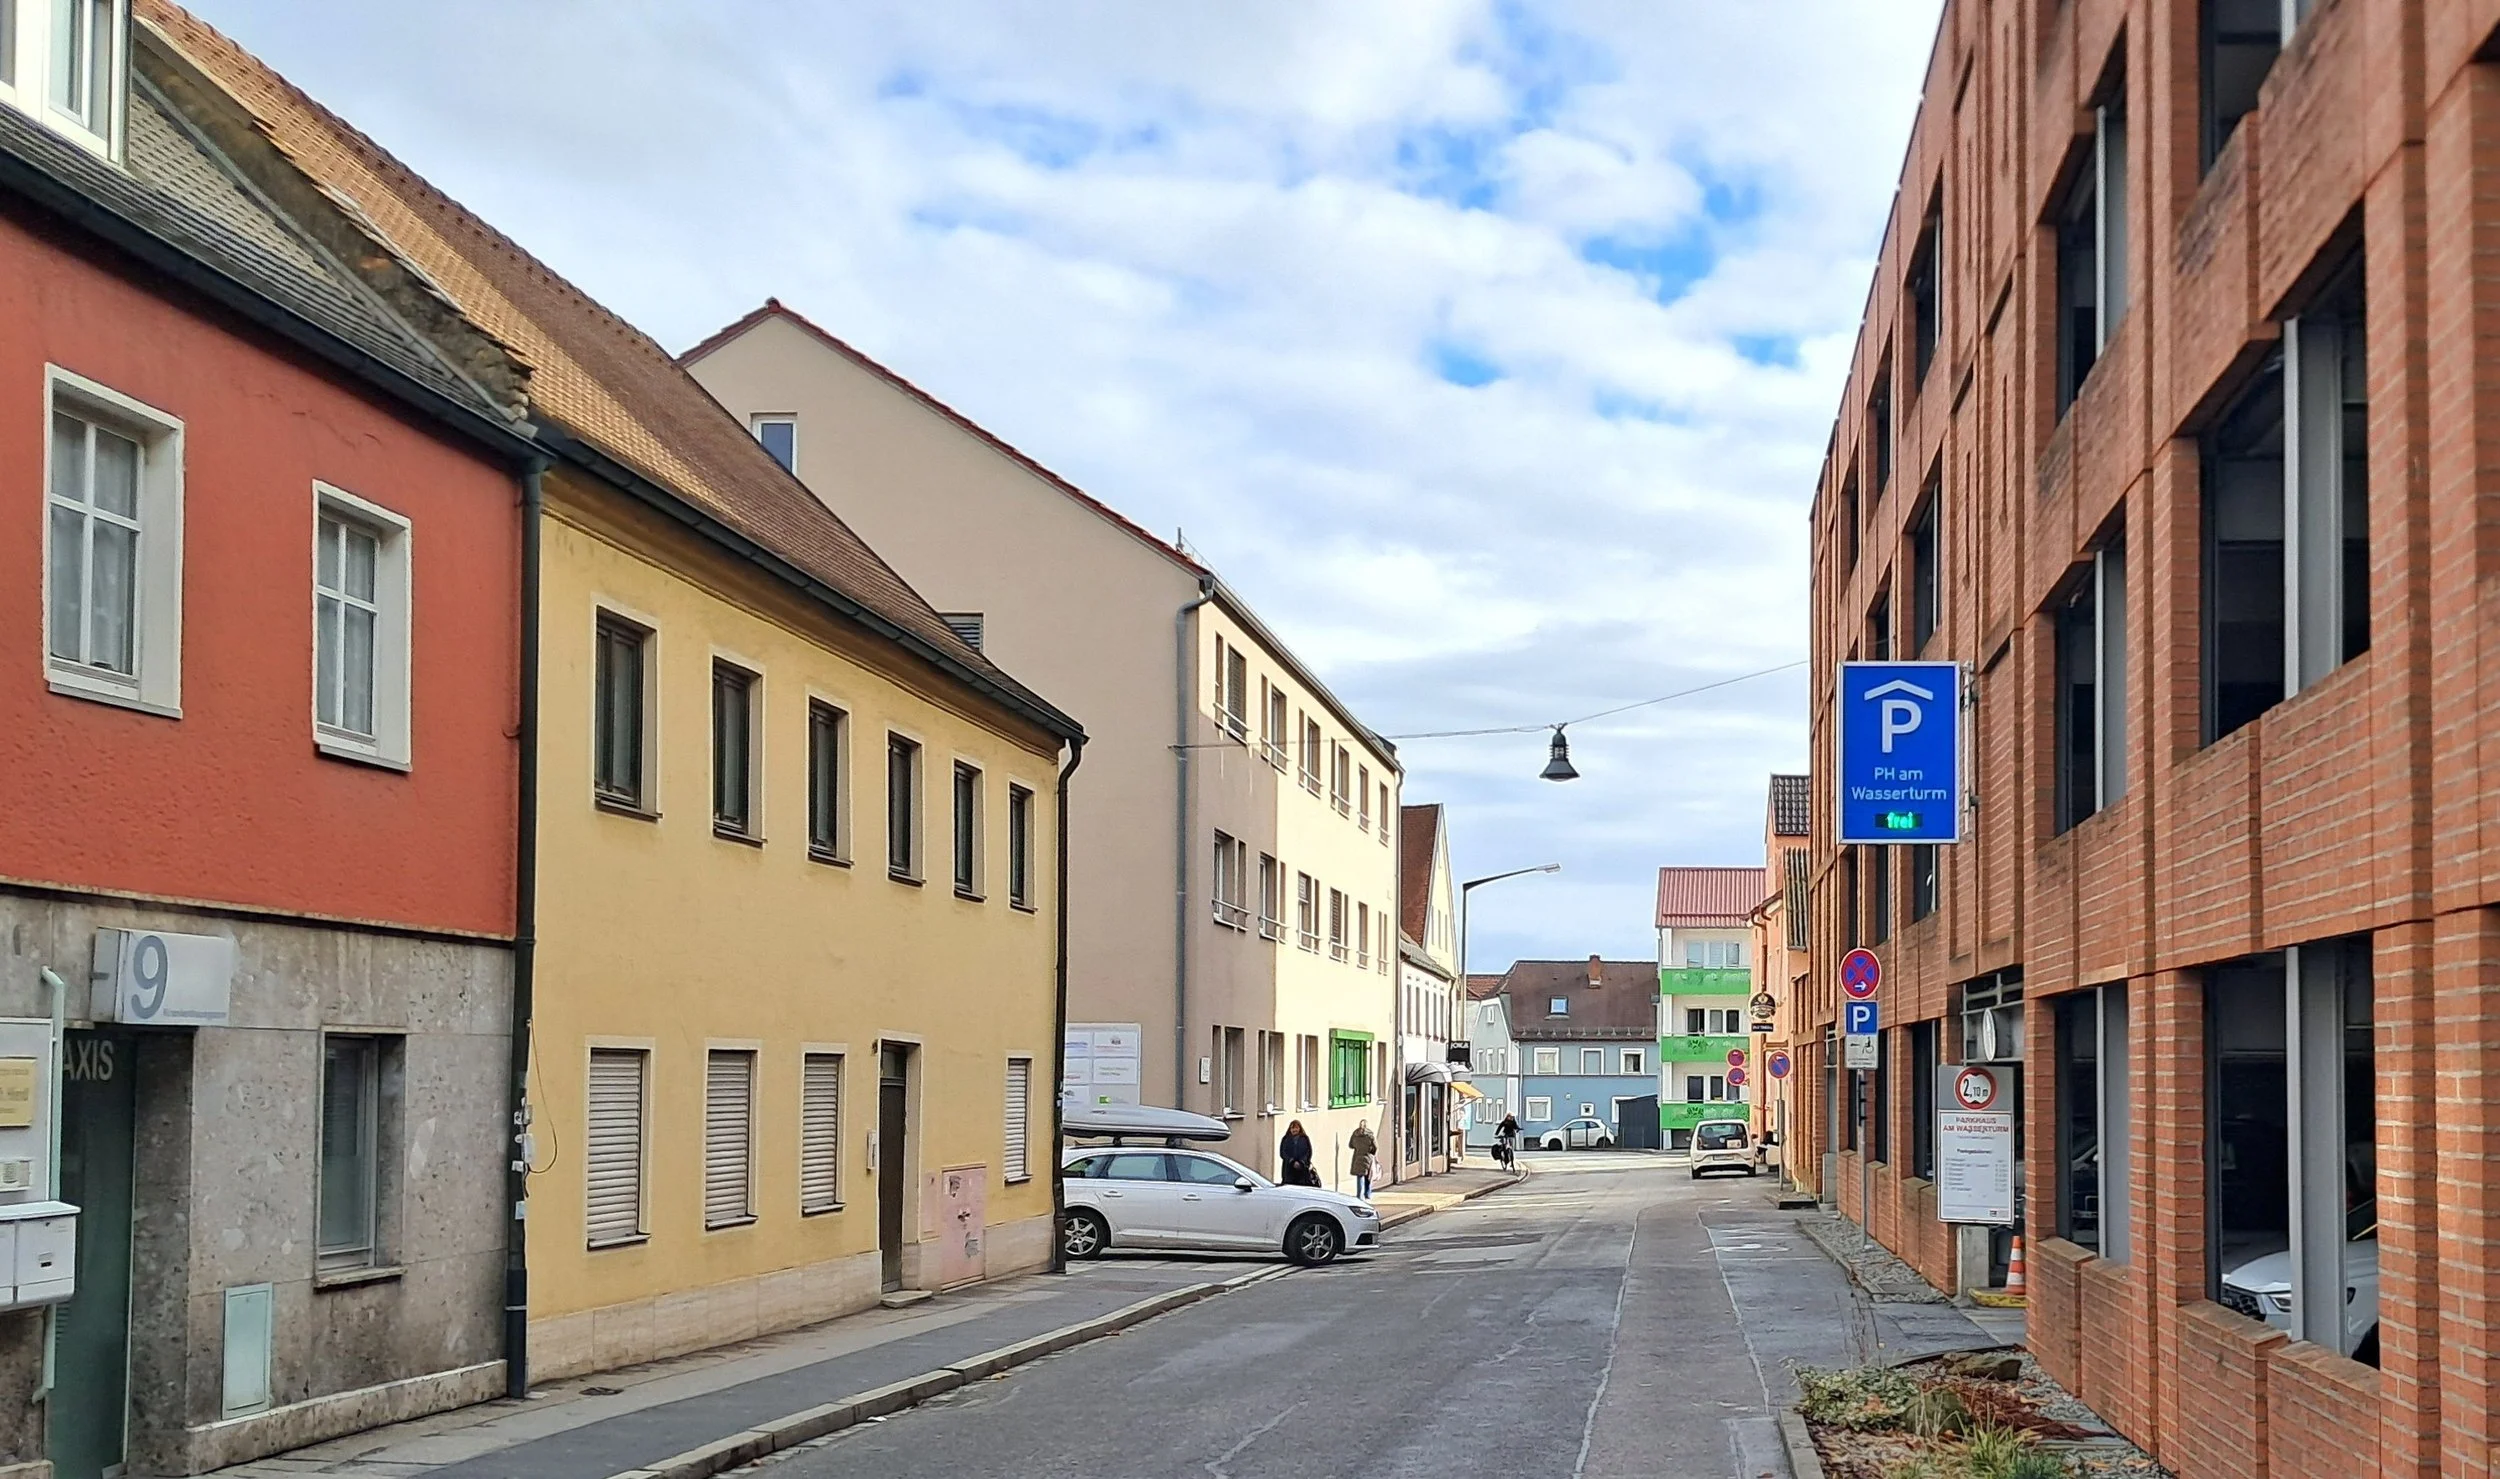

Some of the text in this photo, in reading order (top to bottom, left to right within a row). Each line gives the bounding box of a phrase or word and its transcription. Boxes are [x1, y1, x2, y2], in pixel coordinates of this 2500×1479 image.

[1881, 699, 1923, 754] P
[1874, 767, 1923, 781] PH am
[1851, 786, 1947, 801] Wasserturm
[1886, 811, 1914, 829] frei
[131, 935, 168, 1019] 9
[1852, 1005, 1871, 1032] P
[1956, 1125, 2009, 1133] WASSERTURM
